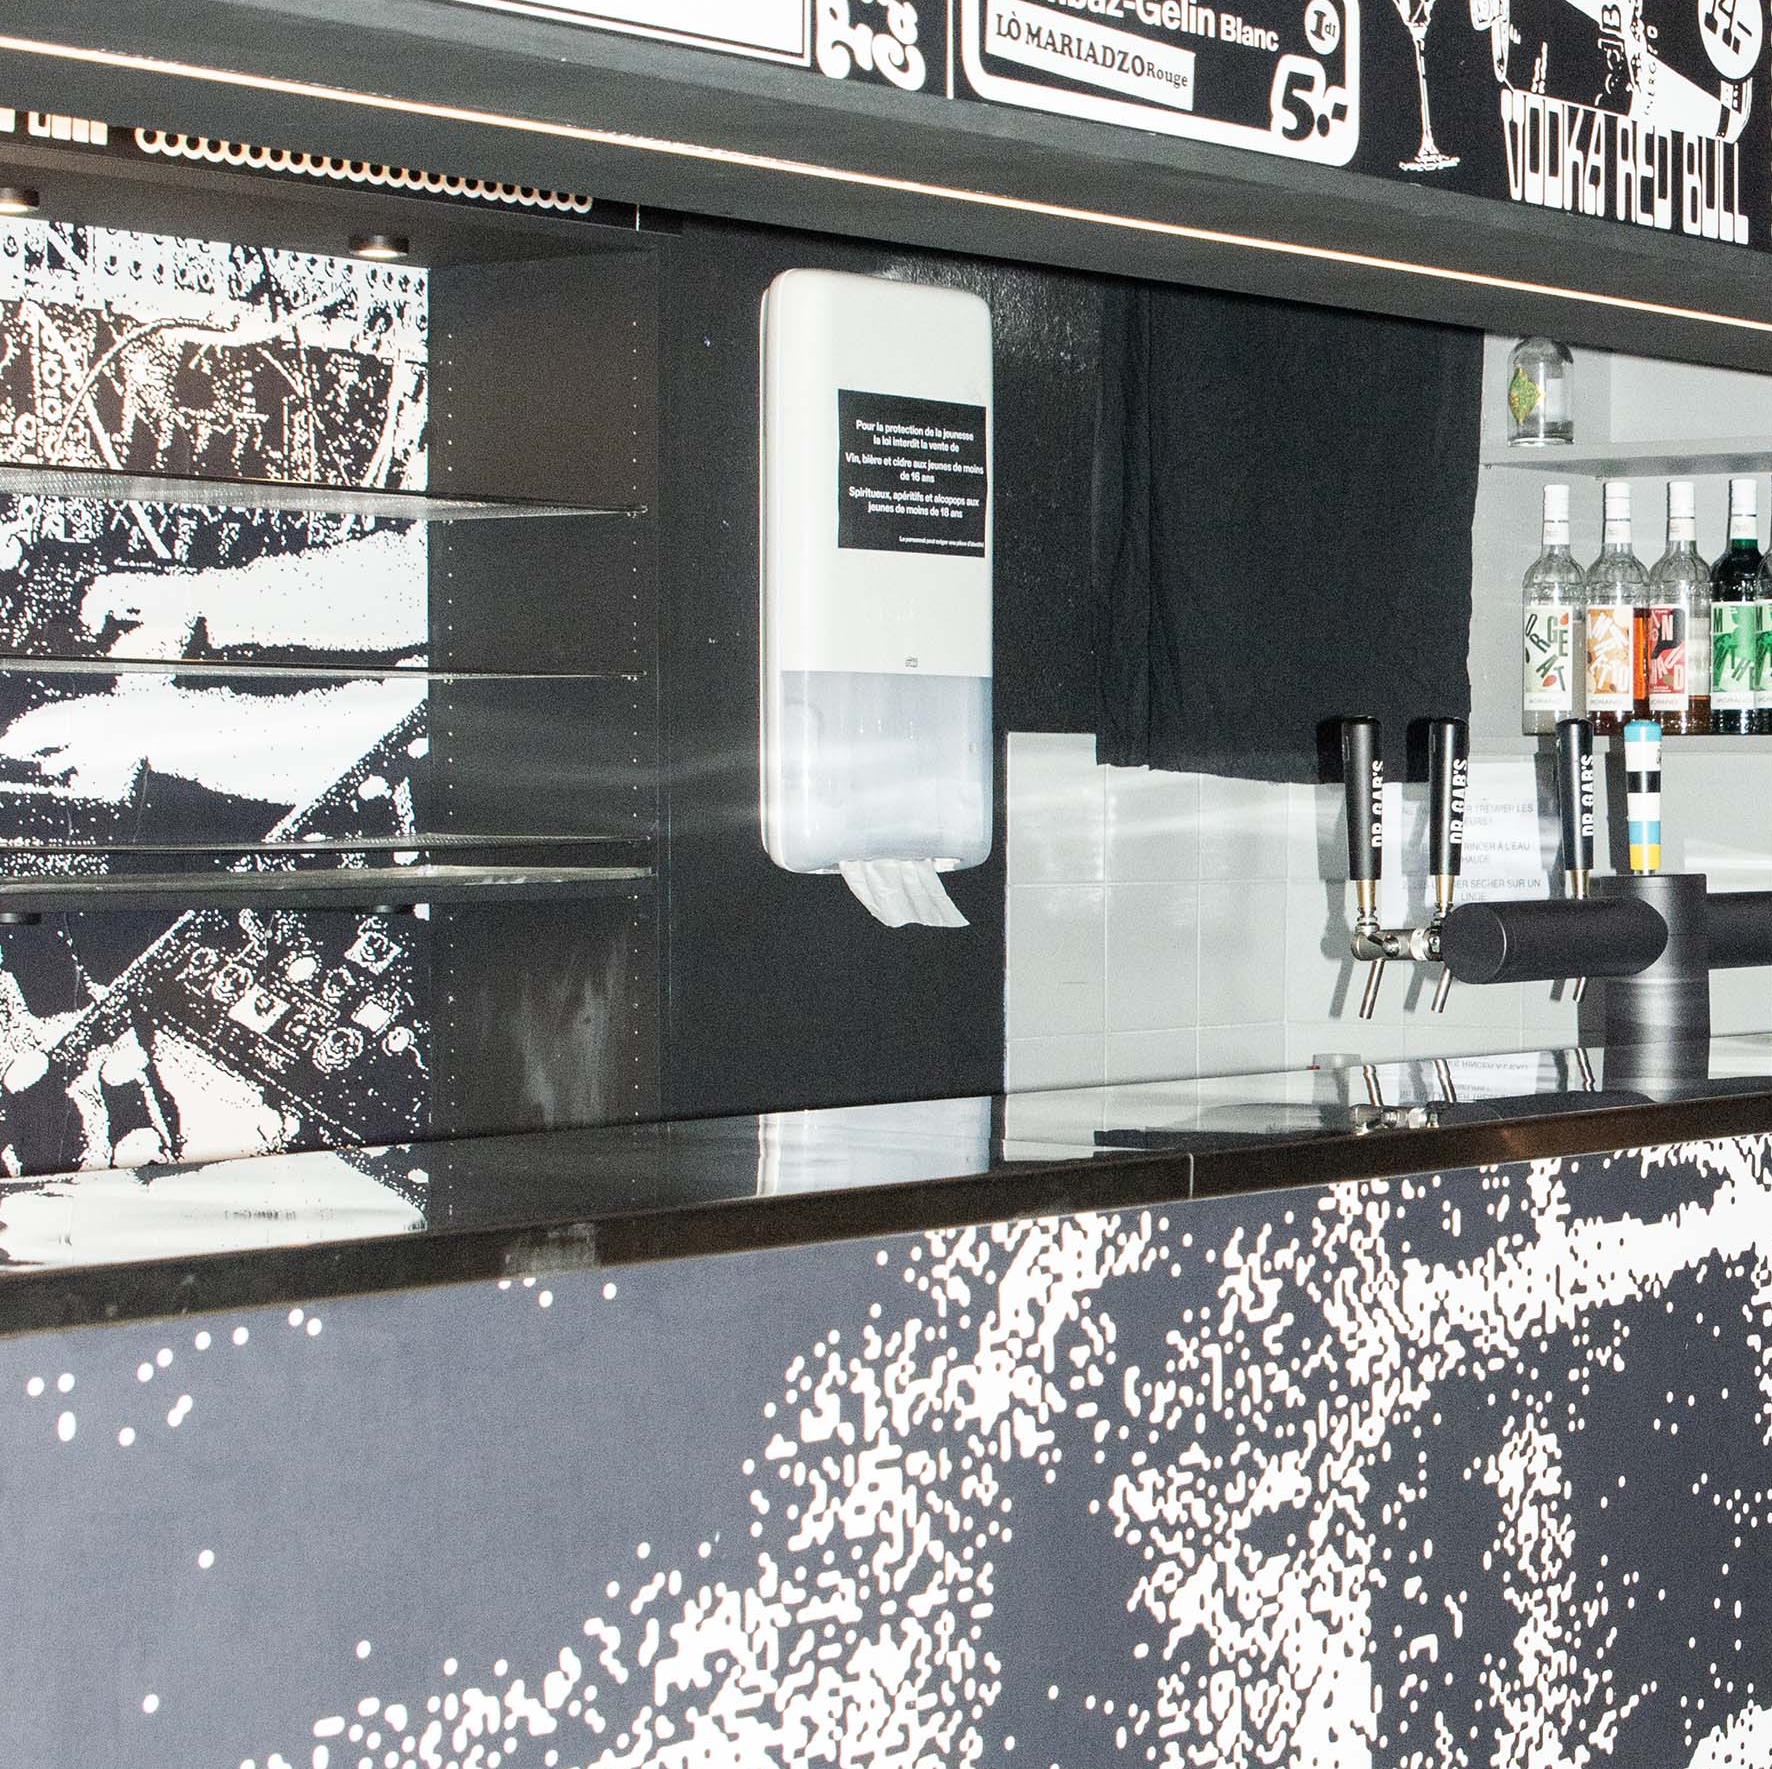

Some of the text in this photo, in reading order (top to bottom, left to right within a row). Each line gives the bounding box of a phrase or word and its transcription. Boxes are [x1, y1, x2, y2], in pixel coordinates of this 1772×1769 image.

[1220, 14, 1281, 53] Blanc
[1147, 58, 1189, 90] Rouge
[1501, 88, 1748, 245] VODKA RED BULL
[855, 419, 974, 441] Pour la protection de la jeunesse
[873, 435, 960, 453] la loi interdit la vente de
[845, 452, 984, 475] Vin, bière et cidre aux jeunes de moins
[899, 471, 935, 483] de 16 ans
[849, 486, 980, 507] Spiritueux, apéritifs et alcopops aux
[867, 502, 963, 519] jeunes de moins de 18 ans
